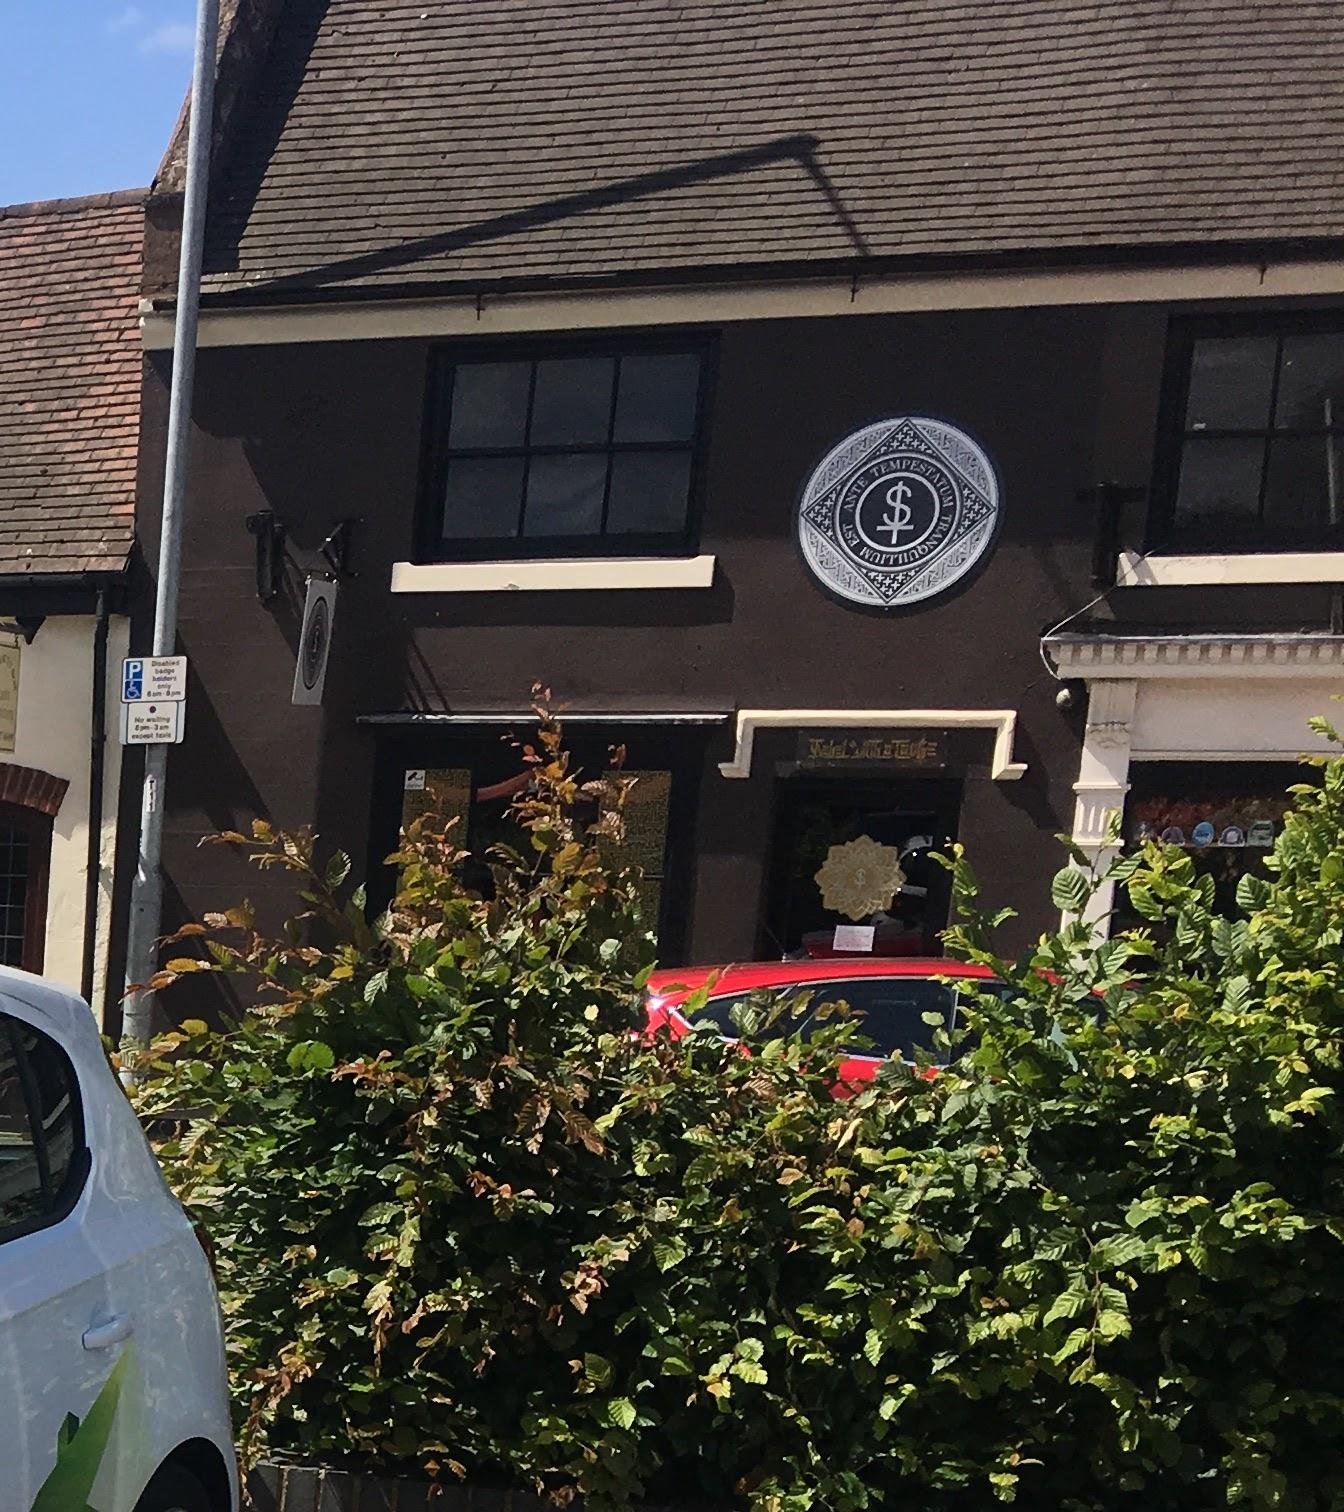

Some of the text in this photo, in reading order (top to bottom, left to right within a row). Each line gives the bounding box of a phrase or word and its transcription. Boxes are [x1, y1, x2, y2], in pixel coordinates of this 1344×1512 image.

[844, 477, 869, 512] ANTE
[870, 459, 954, 508] TEMPESTATUM
[843, 524, 860, 547] EST
